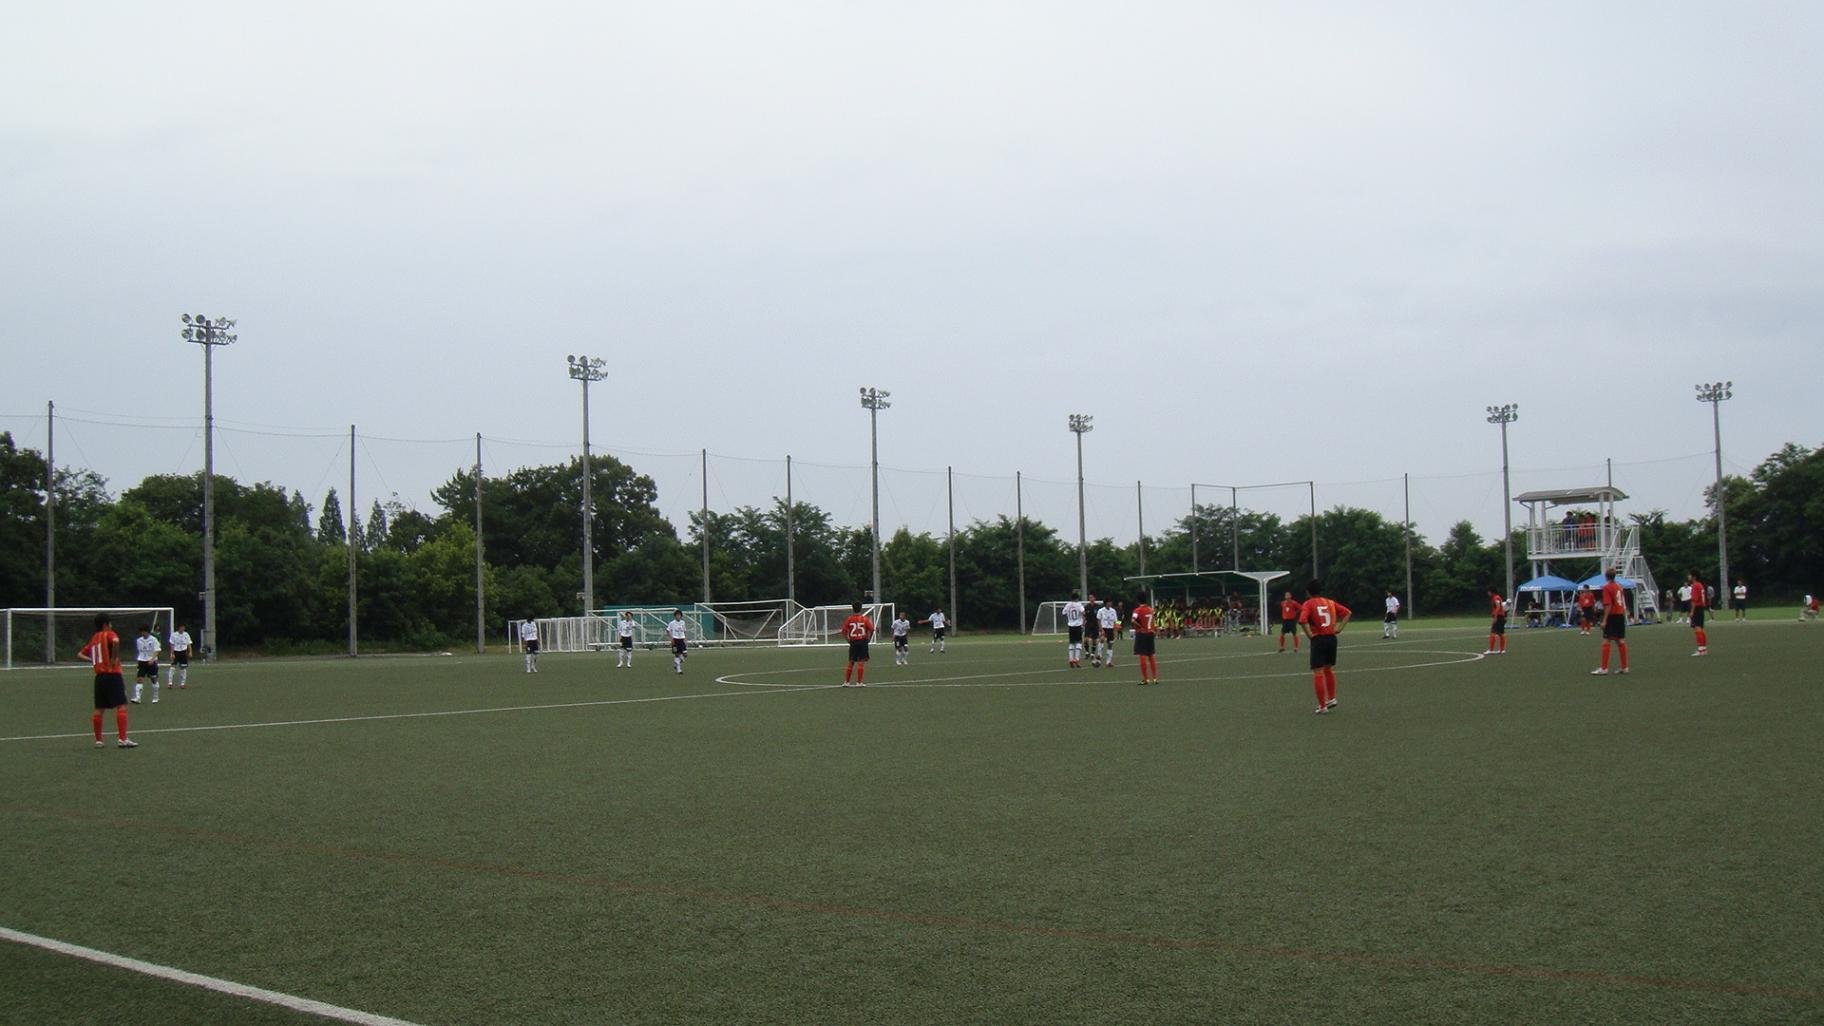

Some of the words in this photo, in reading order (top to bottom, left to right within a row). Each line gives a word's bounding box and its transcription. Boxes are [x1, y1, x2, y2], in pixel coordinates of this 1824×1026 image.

[1317, 605, 1331, 627] 5
[849, 622, 865, 637] 25
[92, 642, 103, 665] 11
